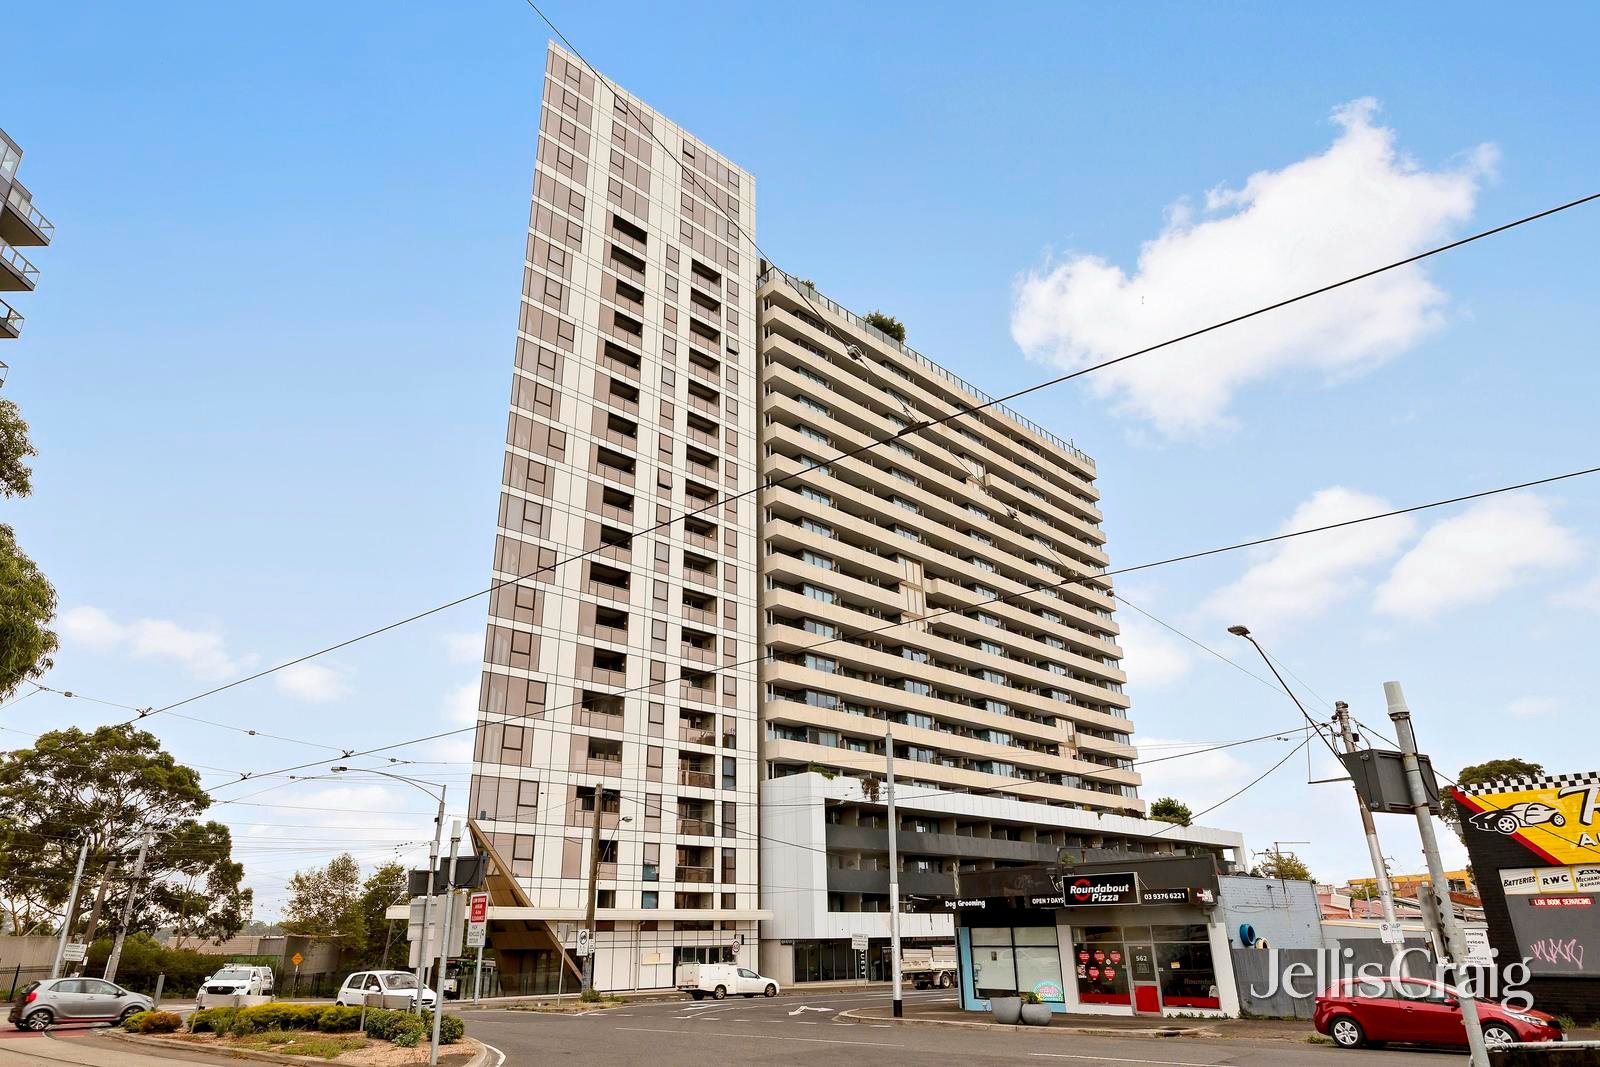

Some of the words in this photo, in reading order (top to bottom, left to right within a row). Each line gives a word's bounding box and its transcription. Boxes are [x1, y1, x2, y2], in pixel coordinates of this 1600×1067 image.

[1504, 876, 1536, 887] BATTERIES
[1542, 875, 1569, 886] RWC
[1070, 883, 1129, 894] Roundabout
[1091, 892, 1119, 902] Pizza
[1547, 898, 1561, 906] BOOK
[1562, 897, 1592, 906] SERVICING
[945, 900, 956, 909] Dog
[958, 899, 985, 909] Grooming
